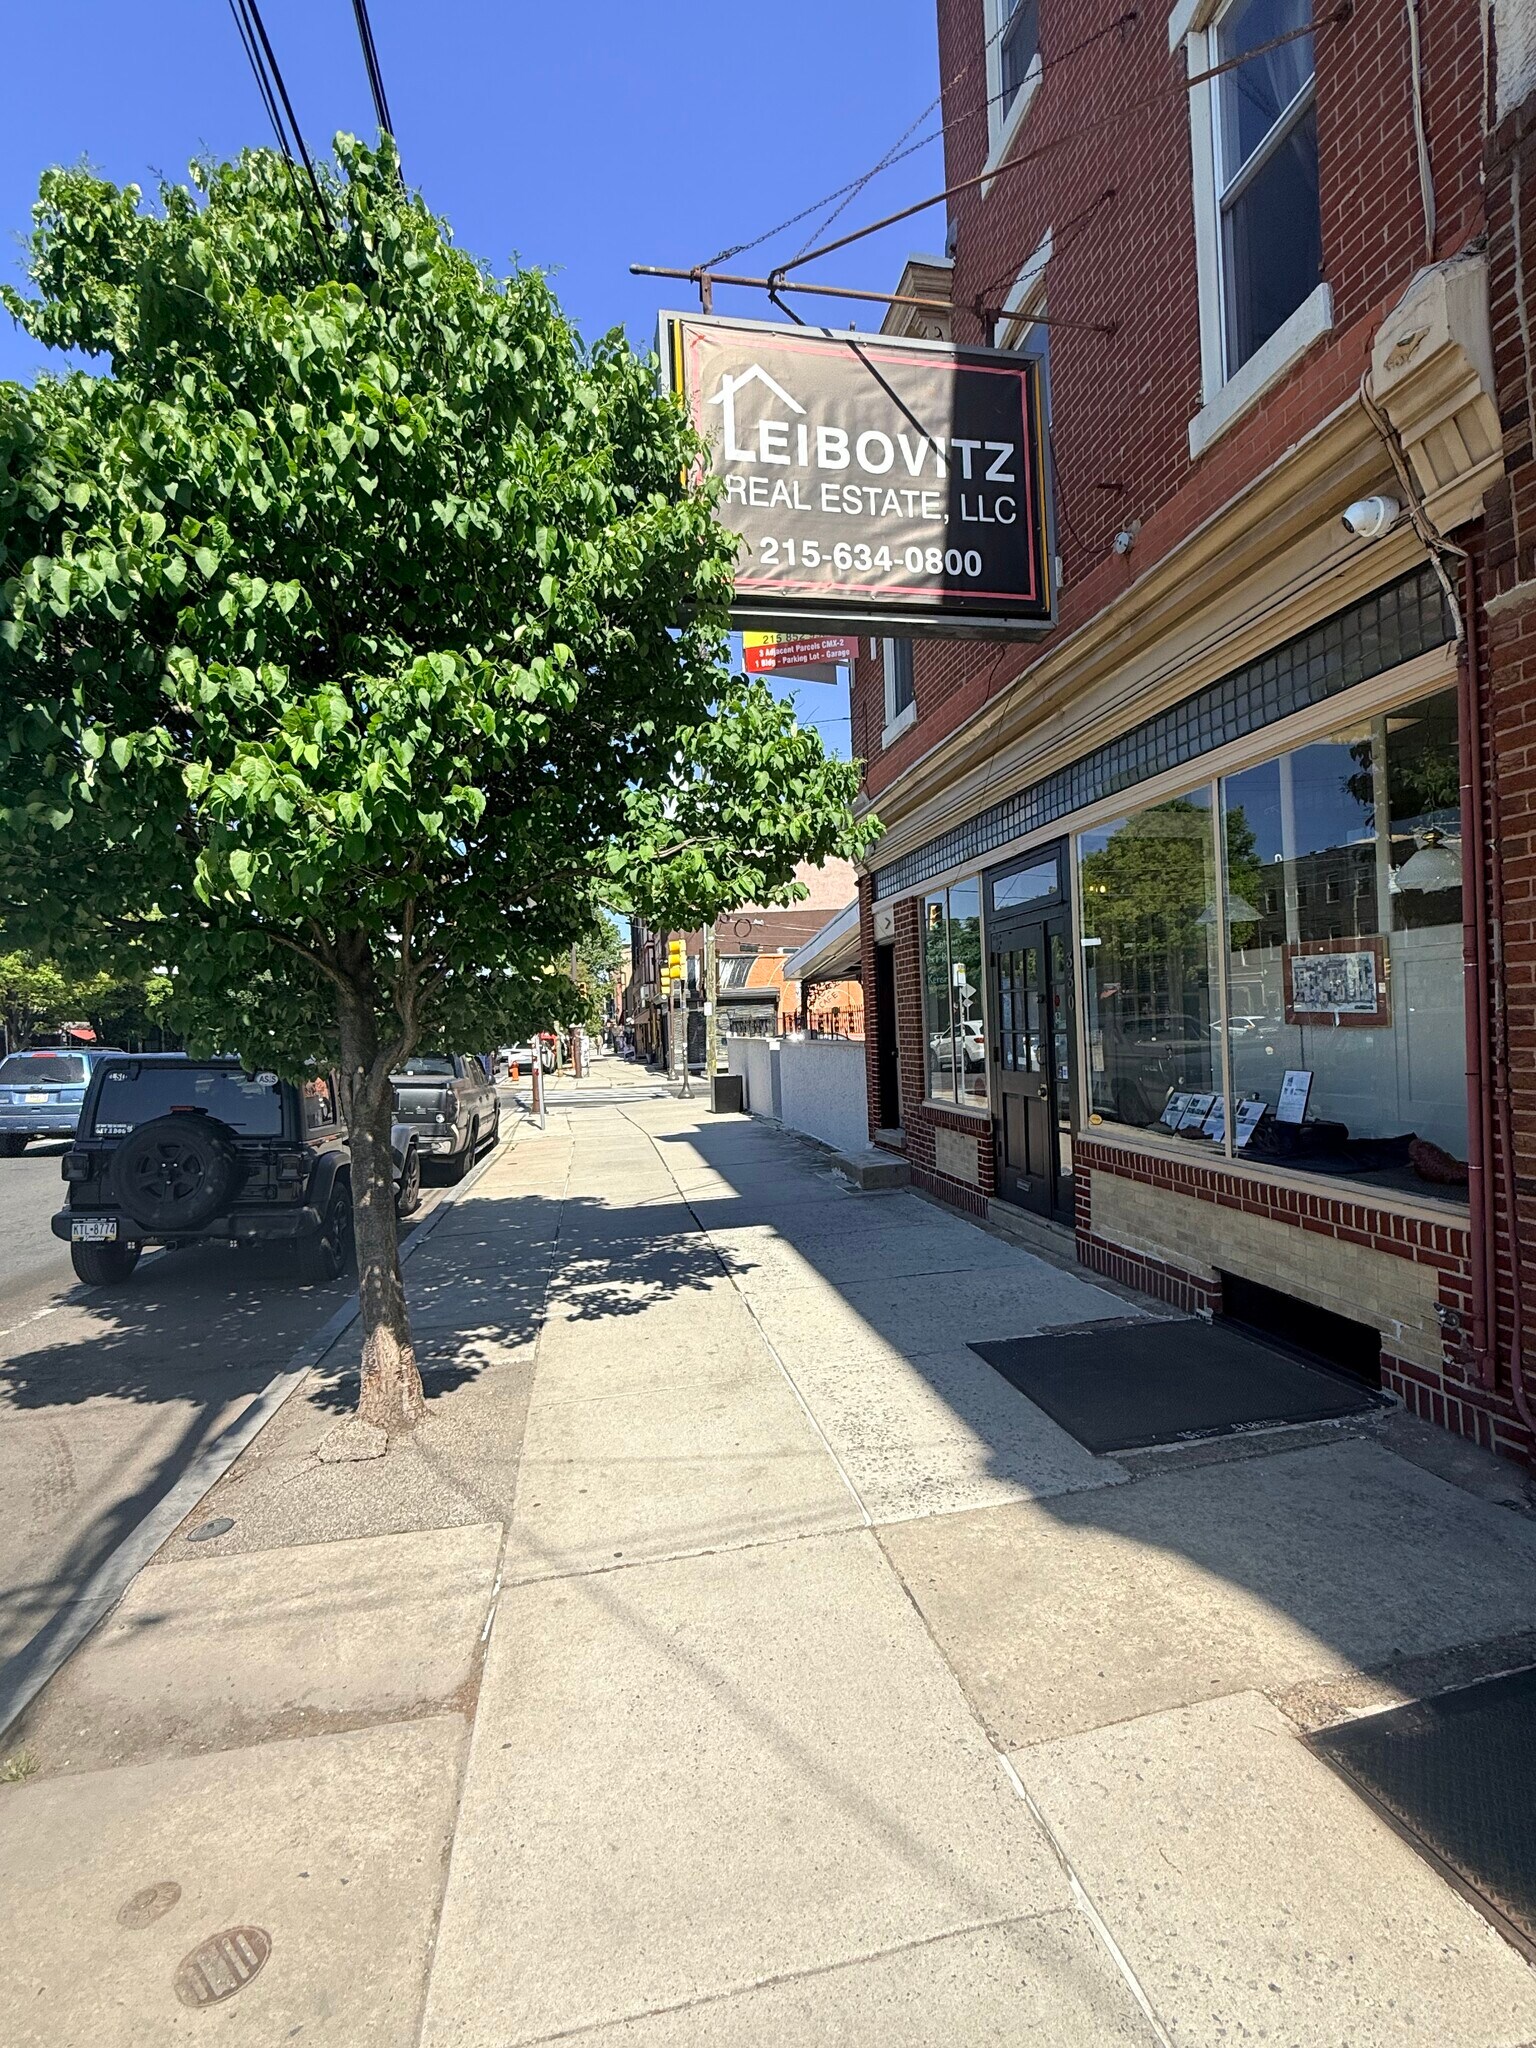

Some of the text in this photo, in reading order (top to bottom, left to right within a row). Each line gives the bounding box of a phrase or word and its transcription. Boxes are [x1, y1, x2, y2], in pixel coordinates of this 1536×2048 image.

[723, 376, 1015, 483] LEIBOVITZ
[726, 475, 1017, 525] REAL ESTATE, LLC
[759, 536, 983, 578] 215-634-0800
[763, 634, 782, 645] 215
[765, 647, 794, 657] Adjacent
[796, 643, 820, 653] Parcels
[821, 638, 845, 648] CMX-2
[782, 654, 808, 665] Parking
[809, 652, 820, 661] Lot
[826, 648, 850, 659] Garage
[818, 991, 839, 1009] CAFE
